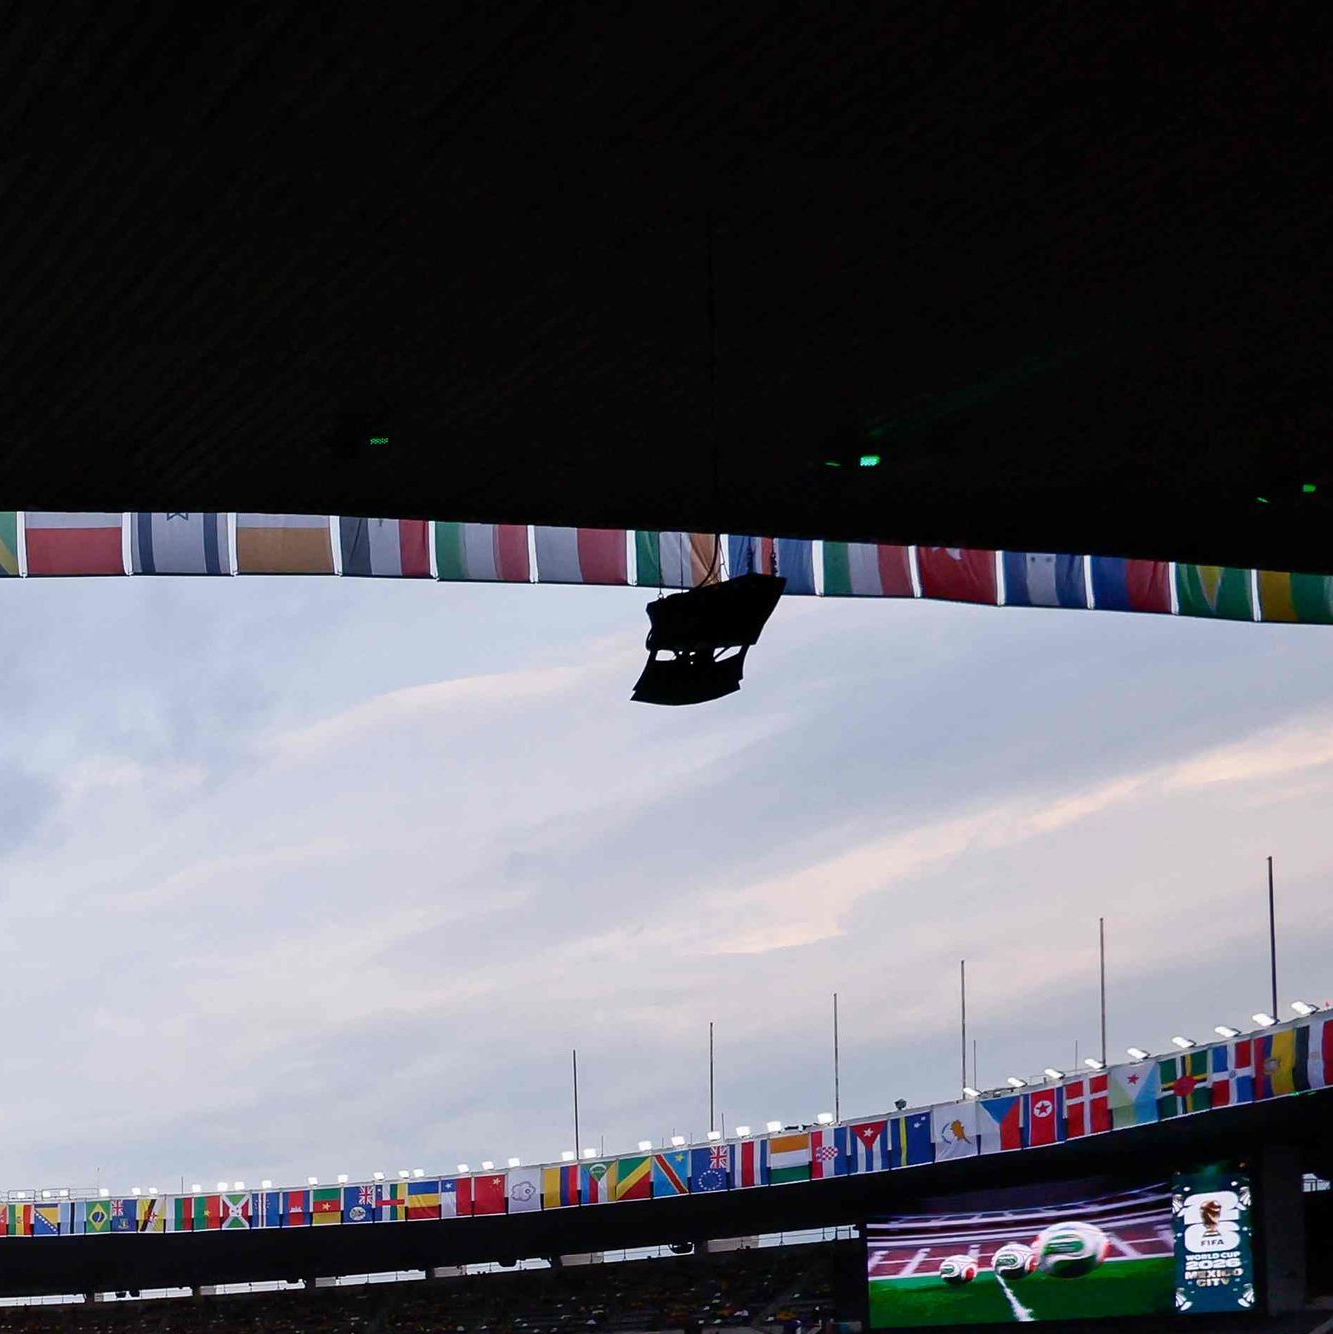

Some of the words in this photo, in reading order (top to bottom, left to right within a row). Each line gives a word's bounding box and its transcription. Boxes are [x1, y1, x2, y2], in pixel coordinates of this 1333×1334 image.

[1185, 1252, 1220, 1260] WORLD
[1185, 1258, 1242, 1271] 2026
[1184, 1268, 1244, 1280] MEXICO
[1196, 1277, 1230, 1287] CITY
